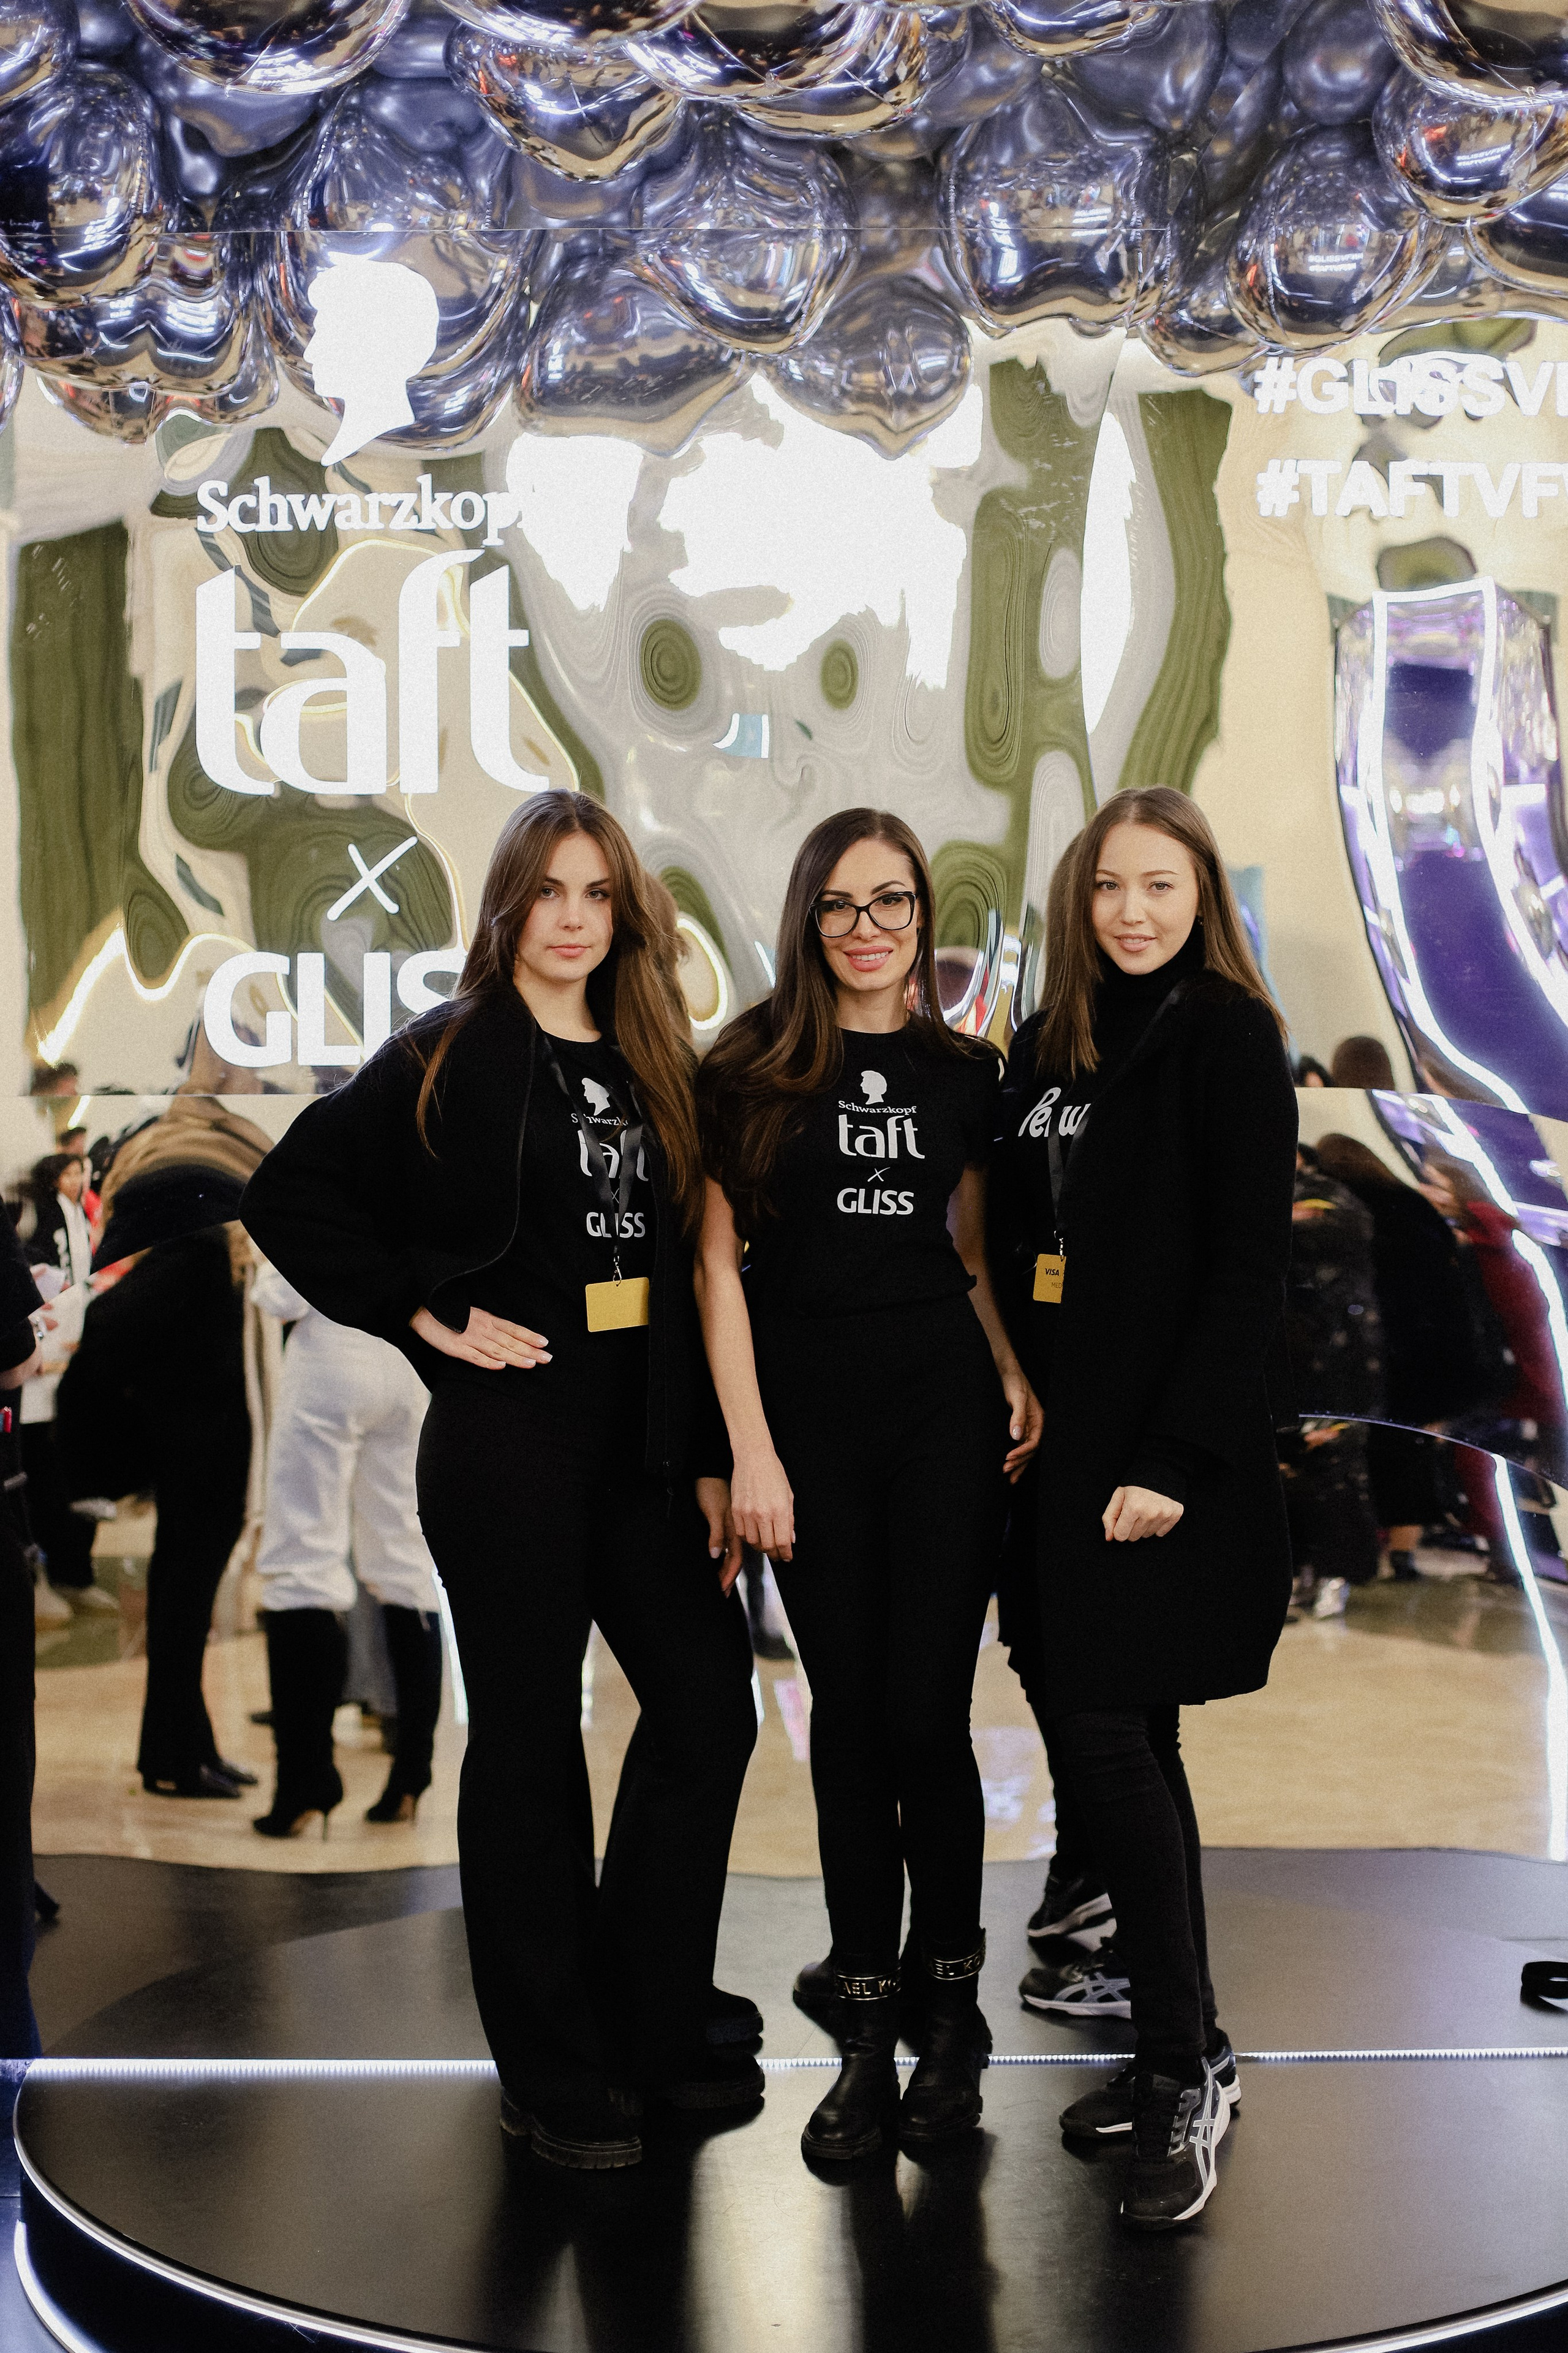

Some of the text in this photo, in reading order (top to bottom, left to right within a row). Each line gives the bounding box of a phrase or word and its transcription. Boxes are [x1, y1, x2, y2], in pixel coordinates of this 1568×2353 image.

[196, 474, 536, 546] Schwarzkop
[195, 549, 549, 795] taft
[203, 951, 470, 1068] GLIS
[839, 1100, 917, 1115] Schwarzkopf
[839, 1114, 925, 1158] taft
[837, 1187, 914, 1215] GLISS
[586, 1212, 646, 1238] GLISS
